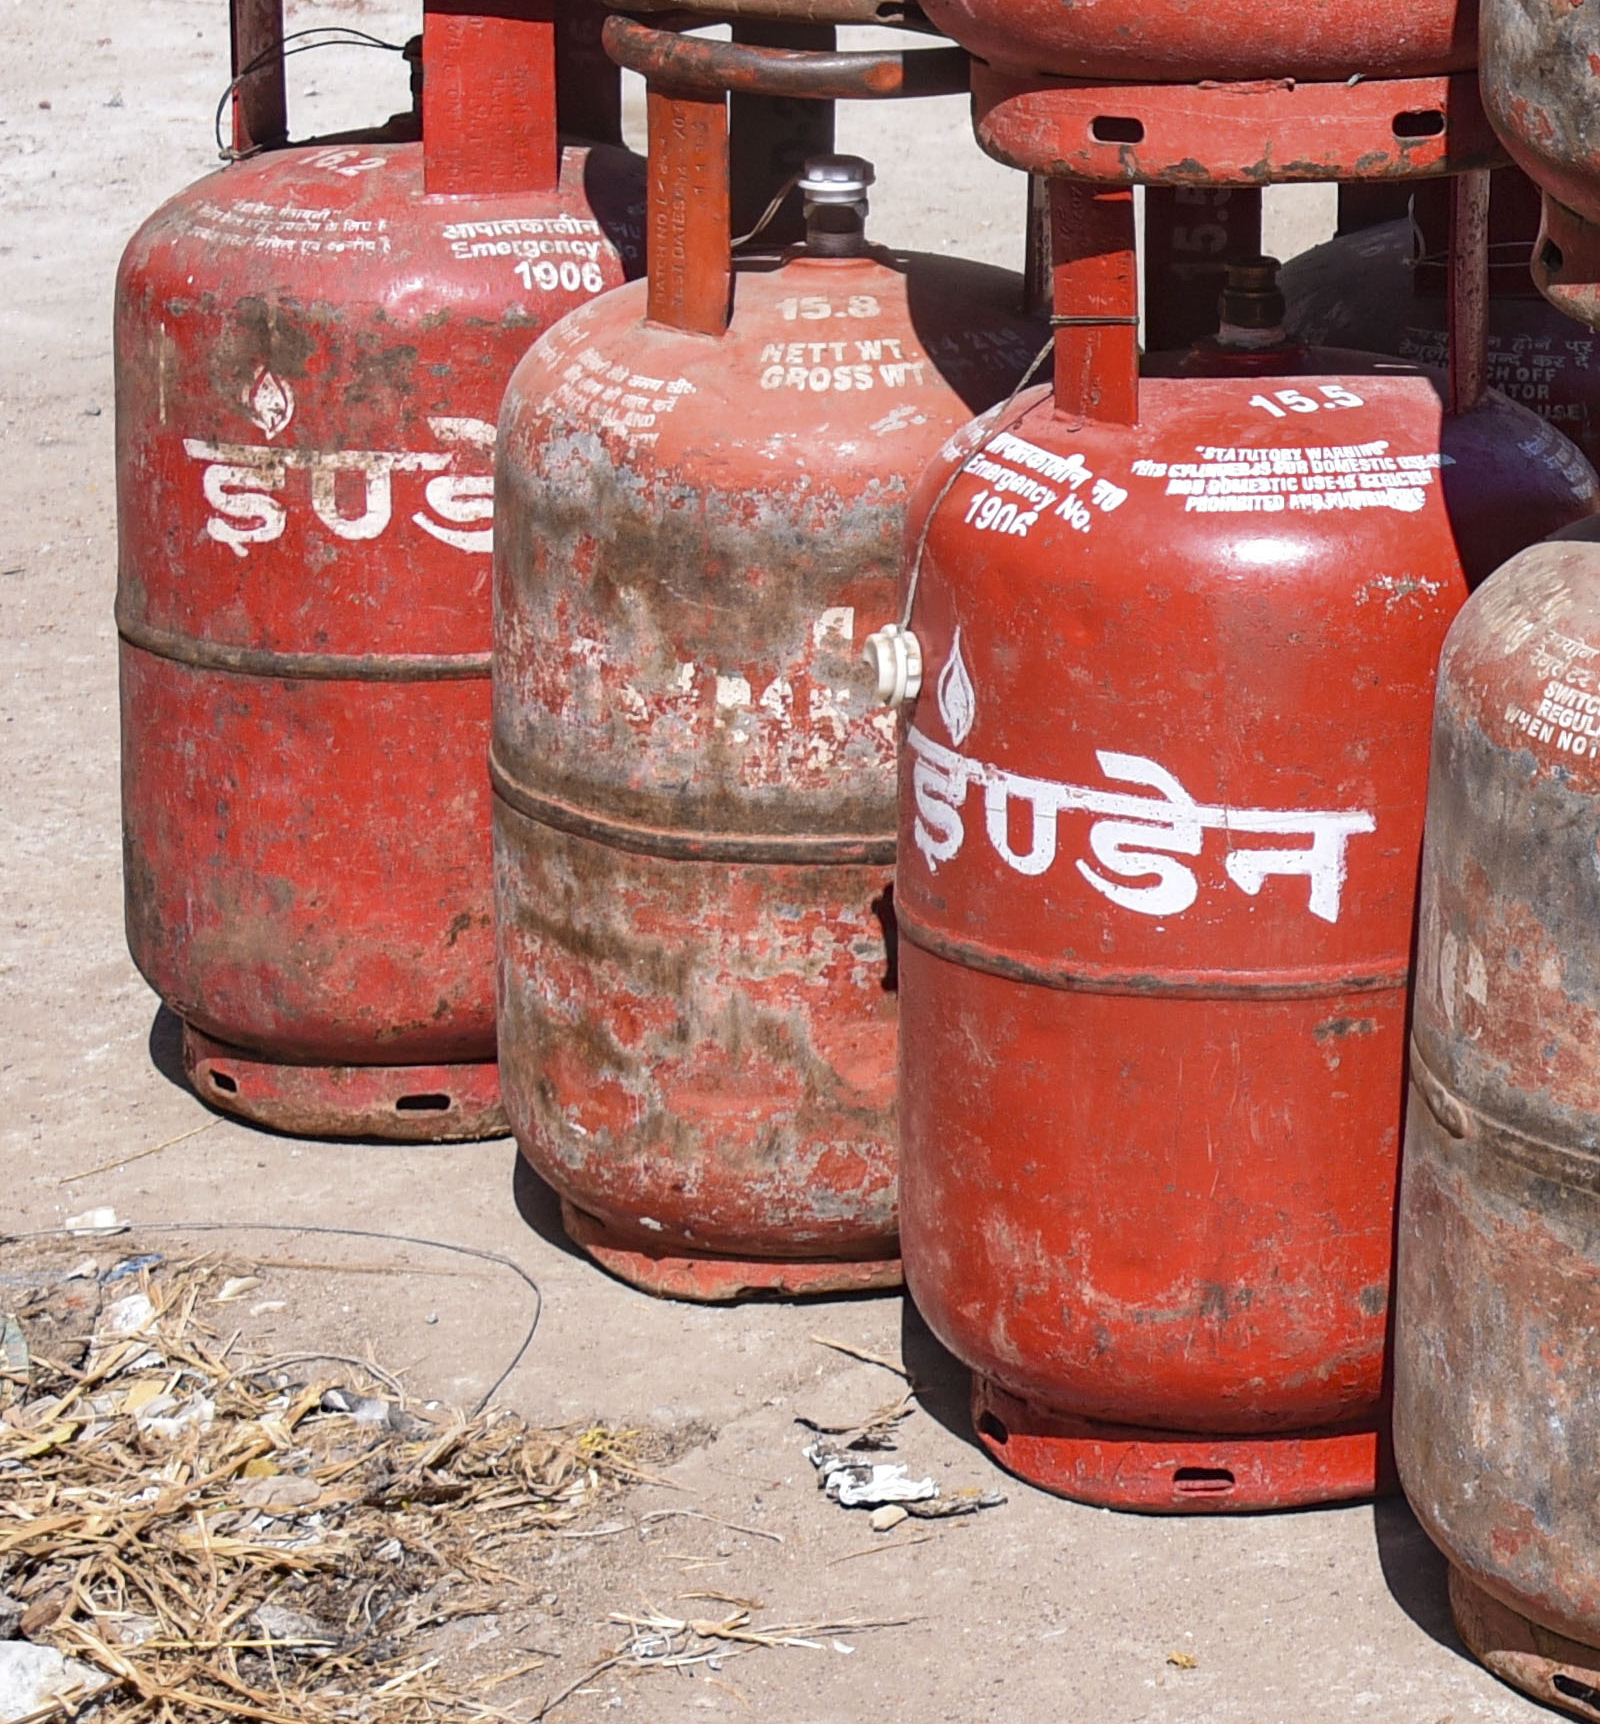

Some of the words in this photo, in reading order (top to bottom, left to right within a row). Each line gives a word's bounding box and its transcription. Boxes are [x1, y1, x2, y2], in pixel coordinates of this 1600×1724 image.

[513, 260, 604, 293] 1906
[775, 294, 881, 321] 15.8
[760, 341, 848, 365] NETT
[760, 363, 874, 392] GROSS
[1515, 367, 1558, 382] OFF
[1247, 385, 1364, 418] 15.5
[963, 452, 1060, 513] Emergency
